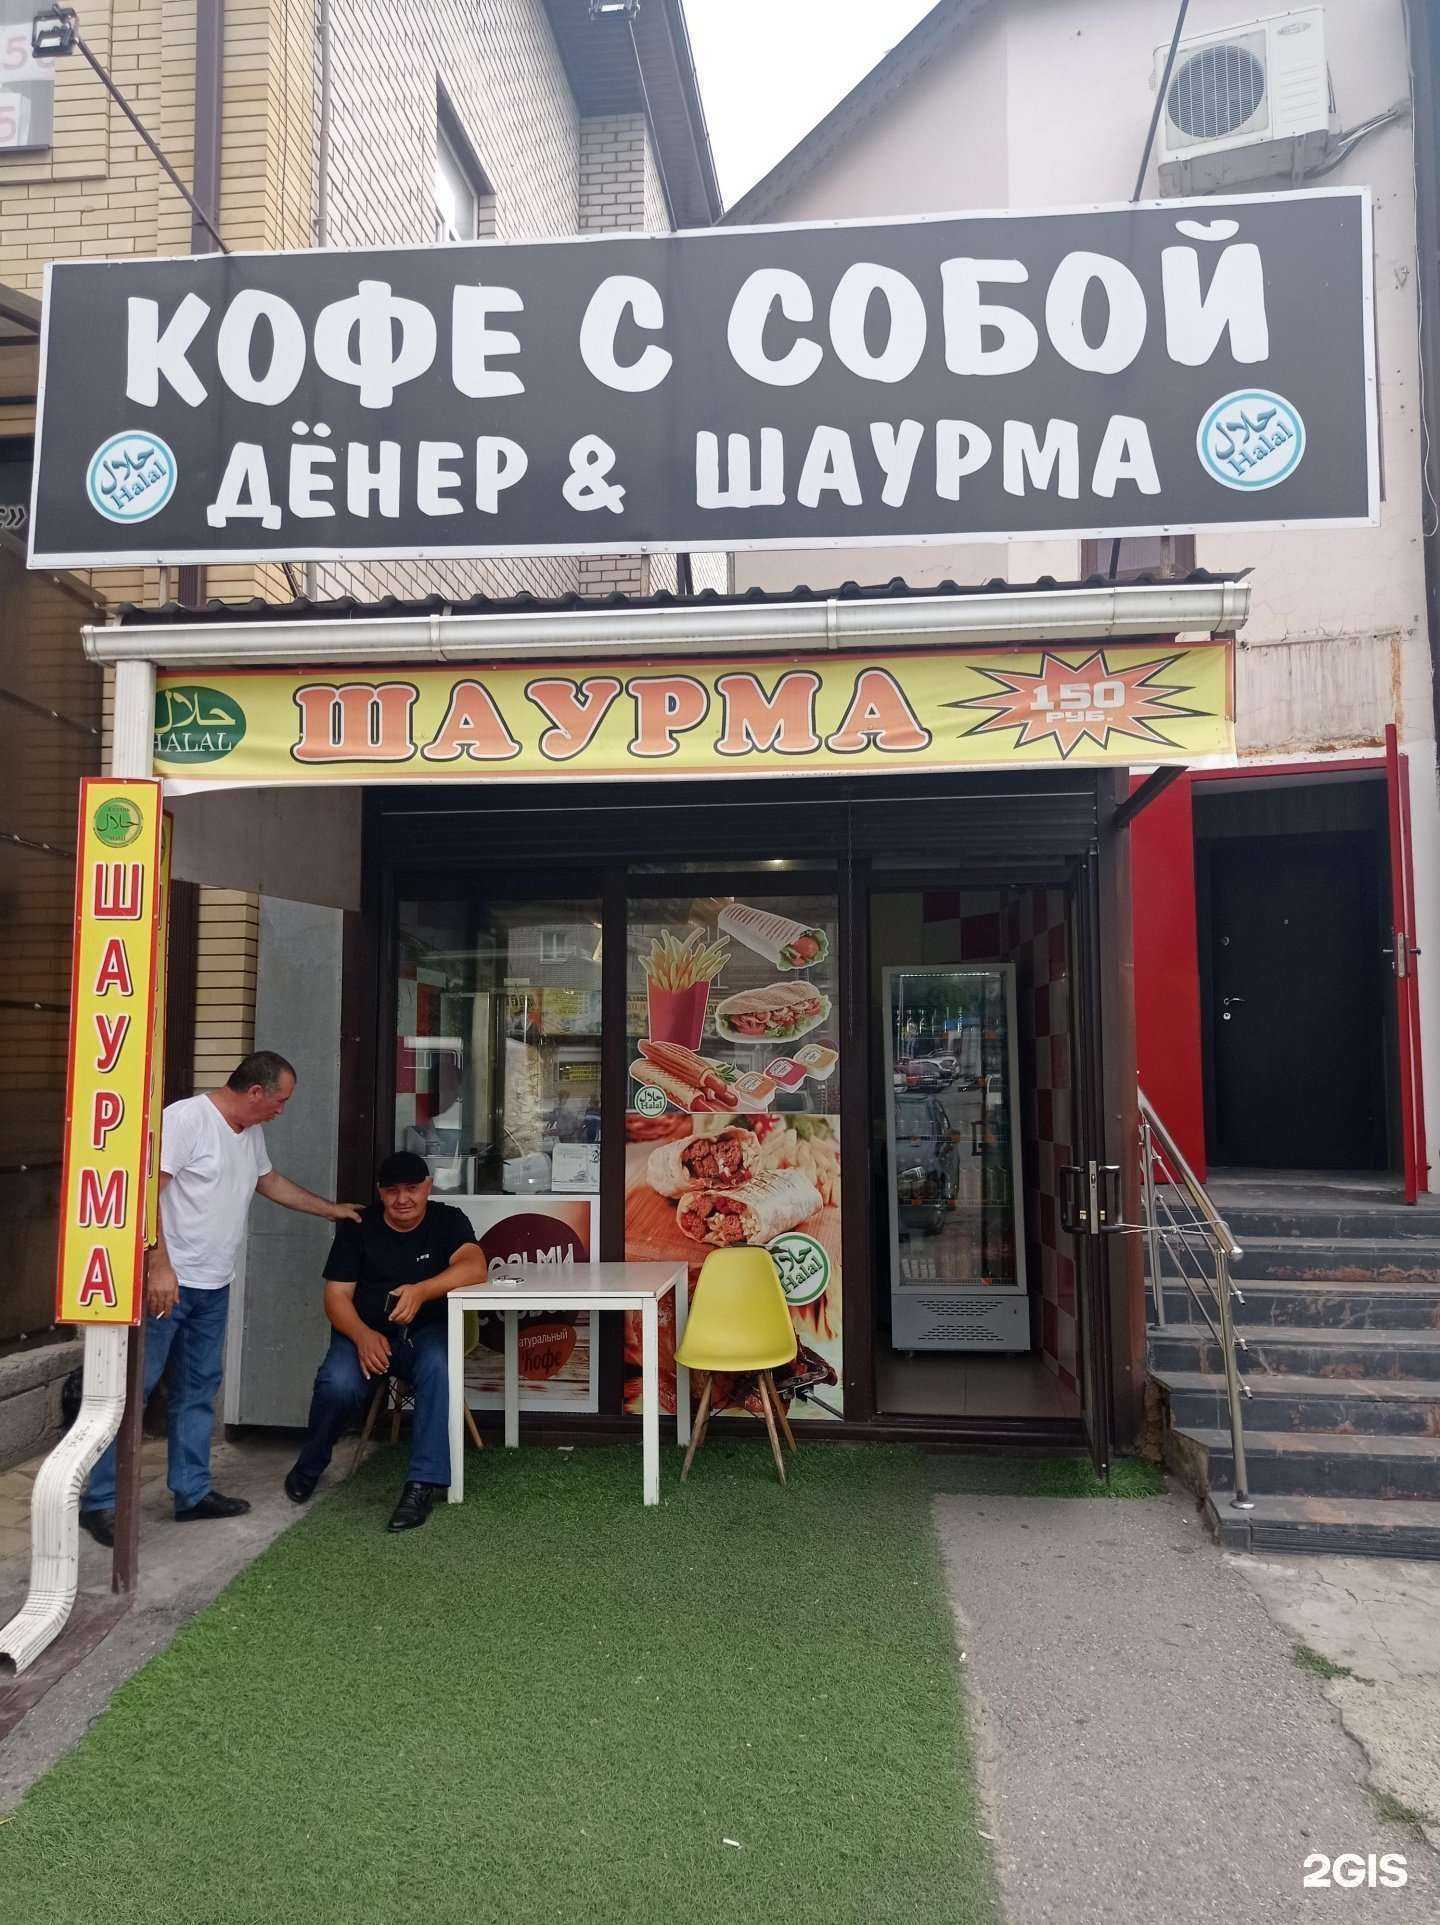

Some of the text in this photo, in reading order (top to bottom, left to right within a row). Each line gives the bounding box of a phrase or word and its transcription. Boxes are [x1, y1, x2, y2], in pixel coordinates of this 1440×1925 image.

[126, 220, 1270, 408] КОФЕ С СОБОЙ
[207, 415, 1161, 529] ДЁНЕР & ШАУРМА
[1227, 421, 1293, 476] Halal
[110, 460, 167, 510] Halal
[292, 667, 932, 764] ШАУРМА
[1030, 681, 1125, 710] 150
[79, 863, 142, 1308] ШАУРМА
[781, 1256, 823, 1294] Halal
[519, 1327, 568, 1348] атуральный
